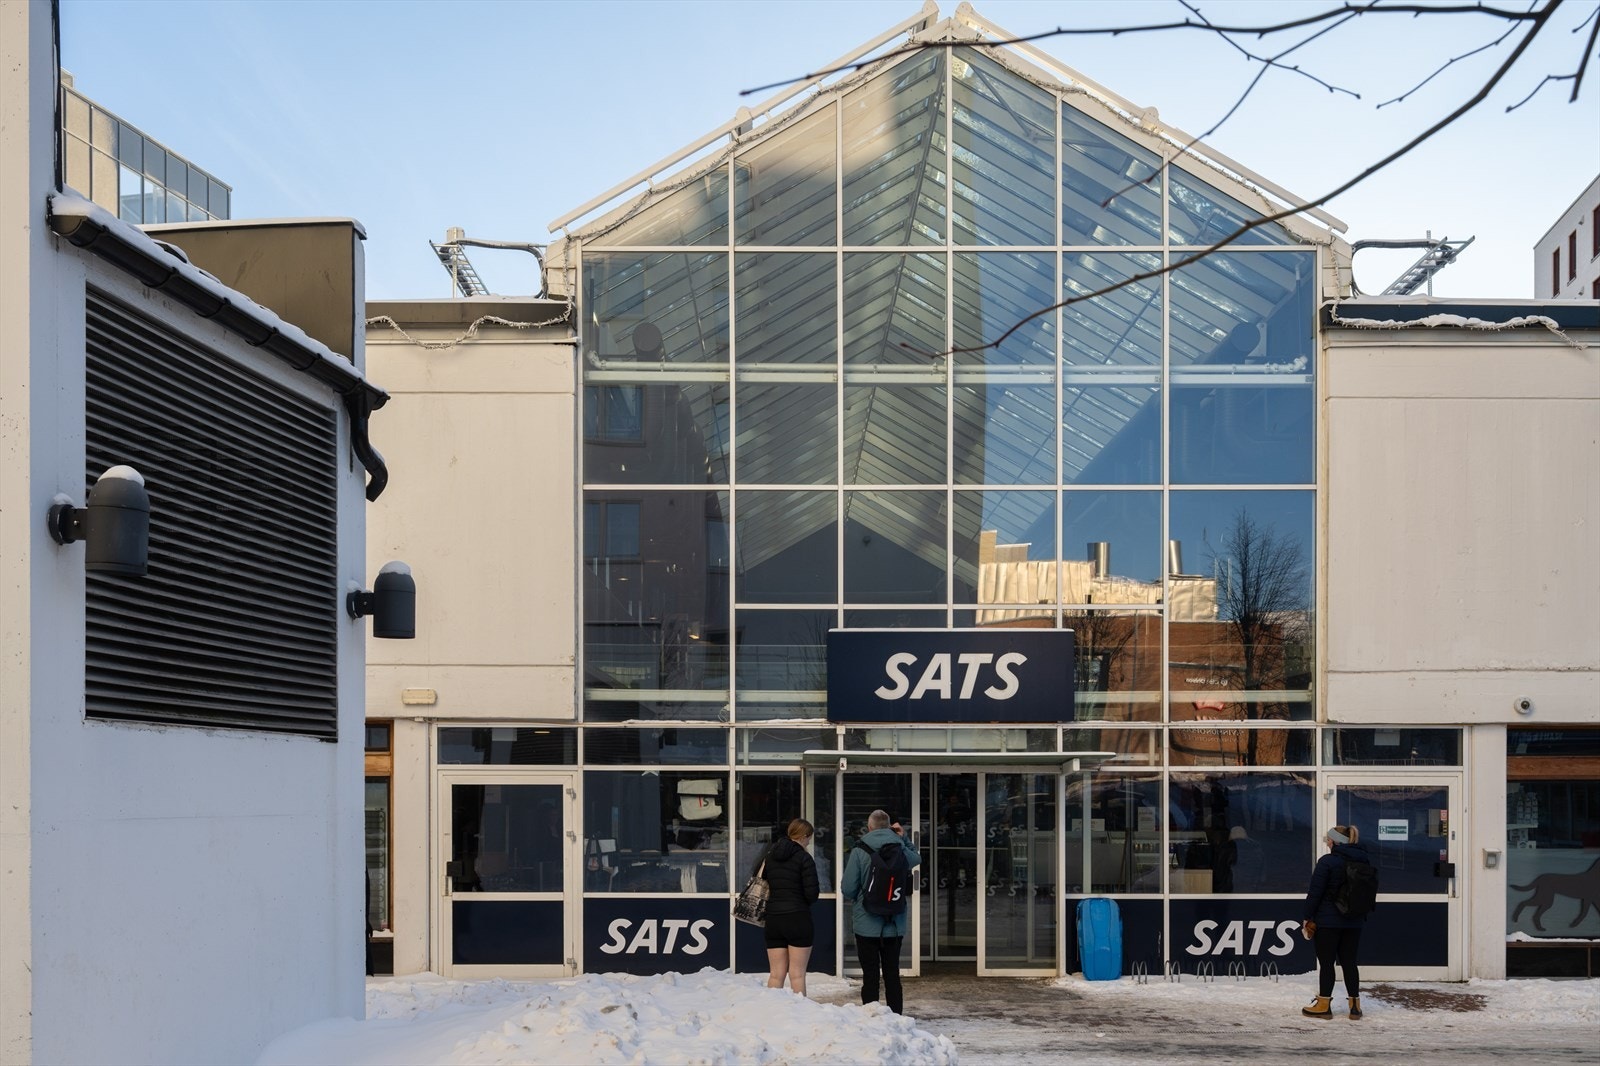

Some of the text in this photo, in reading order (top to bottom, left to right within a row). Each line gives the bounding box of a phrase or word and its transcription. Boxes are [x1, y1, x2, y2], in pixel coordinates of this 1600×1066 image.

[875, 653, 1027, 701] SATS
[600, 919, 714, 955] SATS
[1186, 919, 1301, 957] SATS
